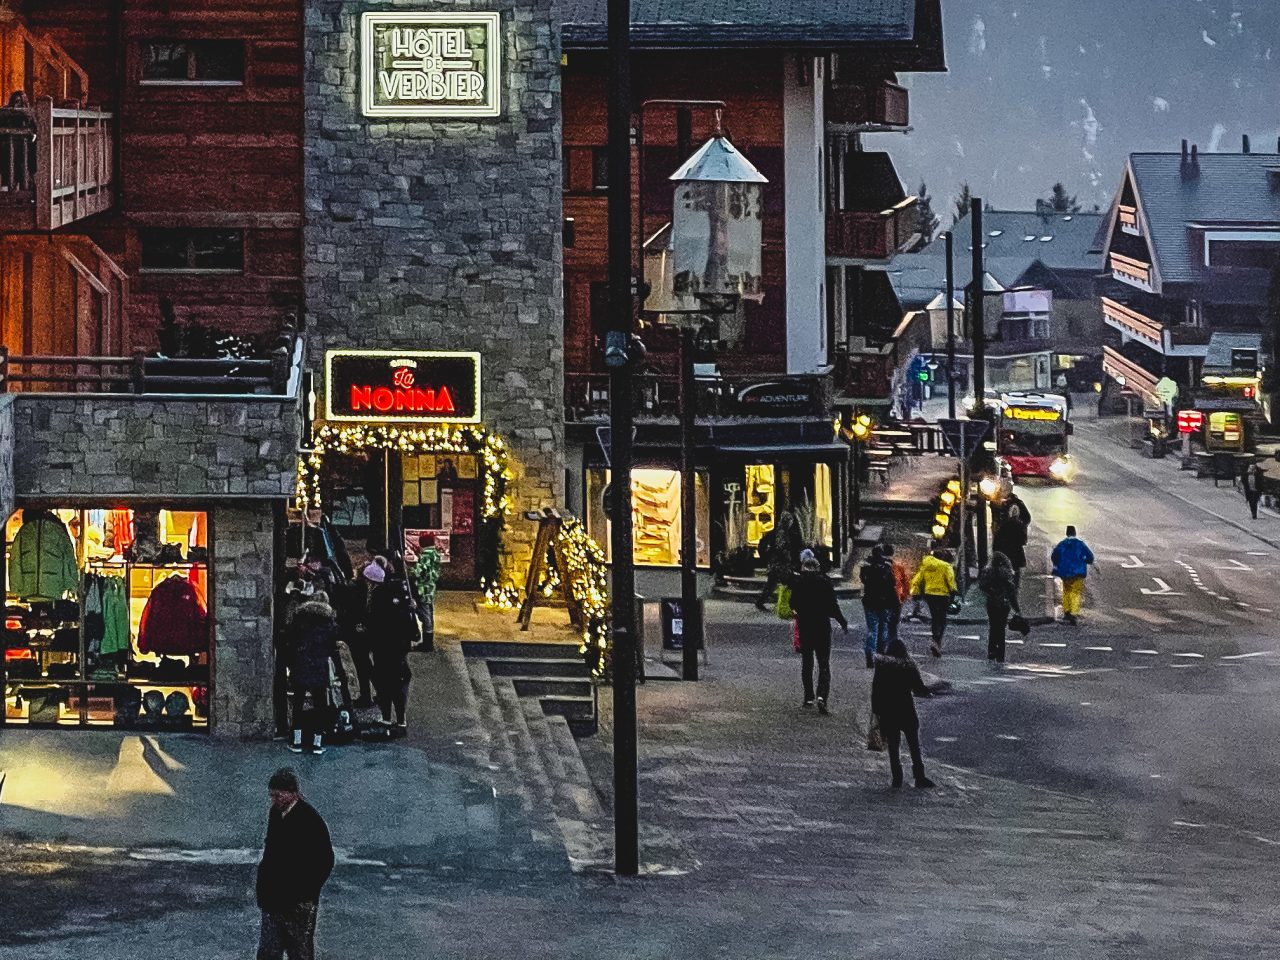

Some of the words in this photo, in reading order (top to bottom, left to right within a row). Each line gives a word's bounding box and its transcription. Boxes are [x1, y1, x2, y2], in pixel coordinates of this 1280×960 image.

[392, 28, 472, 58] HÔTEL
[423, 57, 443, 72] DE
[379, 71, 485, 100] VERBIER
[394, 368, 415, 388] La
[351, 385, 455, 412] NONNA
